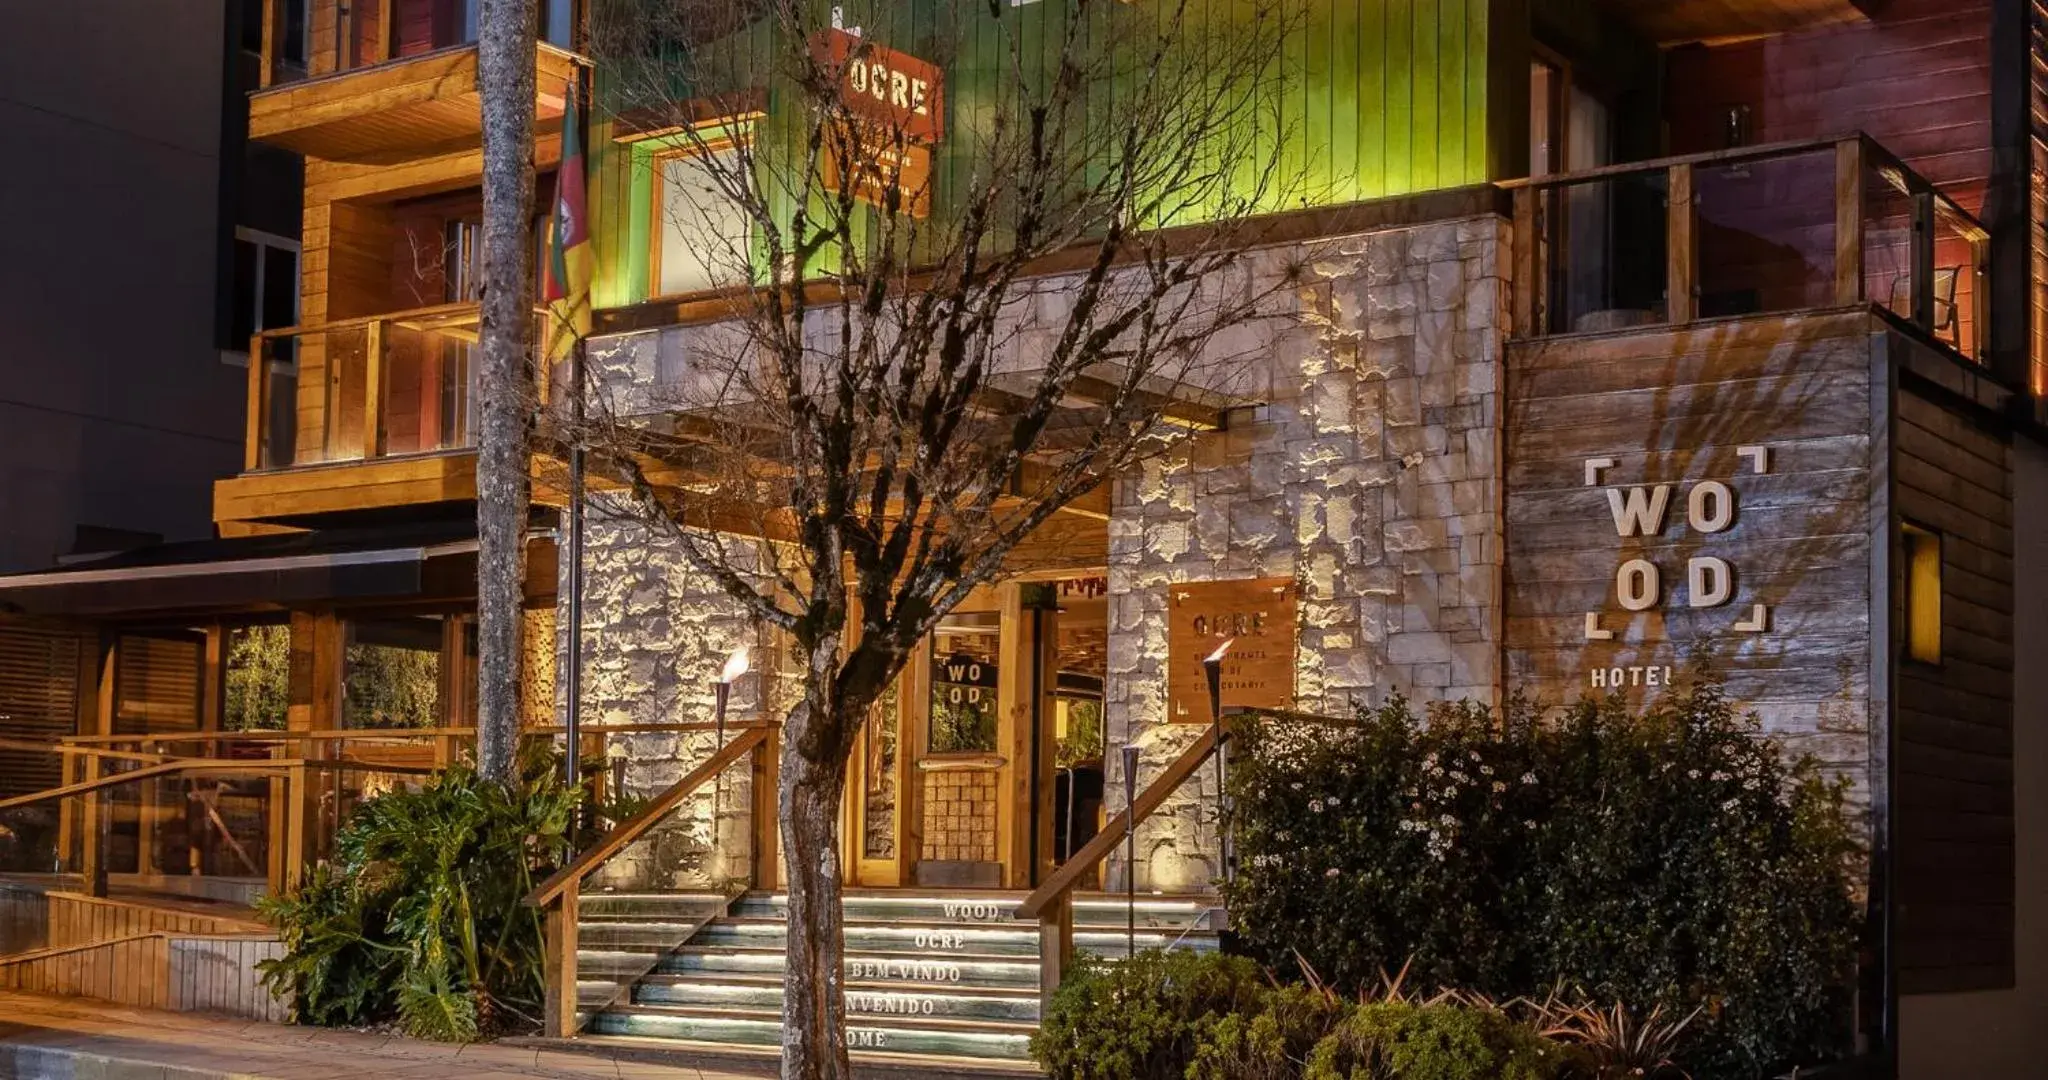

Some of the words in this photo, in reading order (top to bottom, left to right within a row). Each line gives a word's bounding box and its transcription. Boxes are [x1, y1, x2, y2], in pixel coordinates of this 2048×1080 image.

[850, 57, 928, 116] OCRE
[1606, 481, 1732, 536] WO
[1617, 556, 1731, 611] OD
[1193, 611, 1268, 637] OCRE
[948, 664, 980, 681] WO
[1591, 665, 1673, 688] HOTEL
[950, 687, 980, 704] OD
[943, 903, 999, 918] WOOD
[915, 934, 965, 949] OCRE
[852, 963, 961, 981] BEM-VINDO
[845, 996, 934, 1014] NVENIDO
